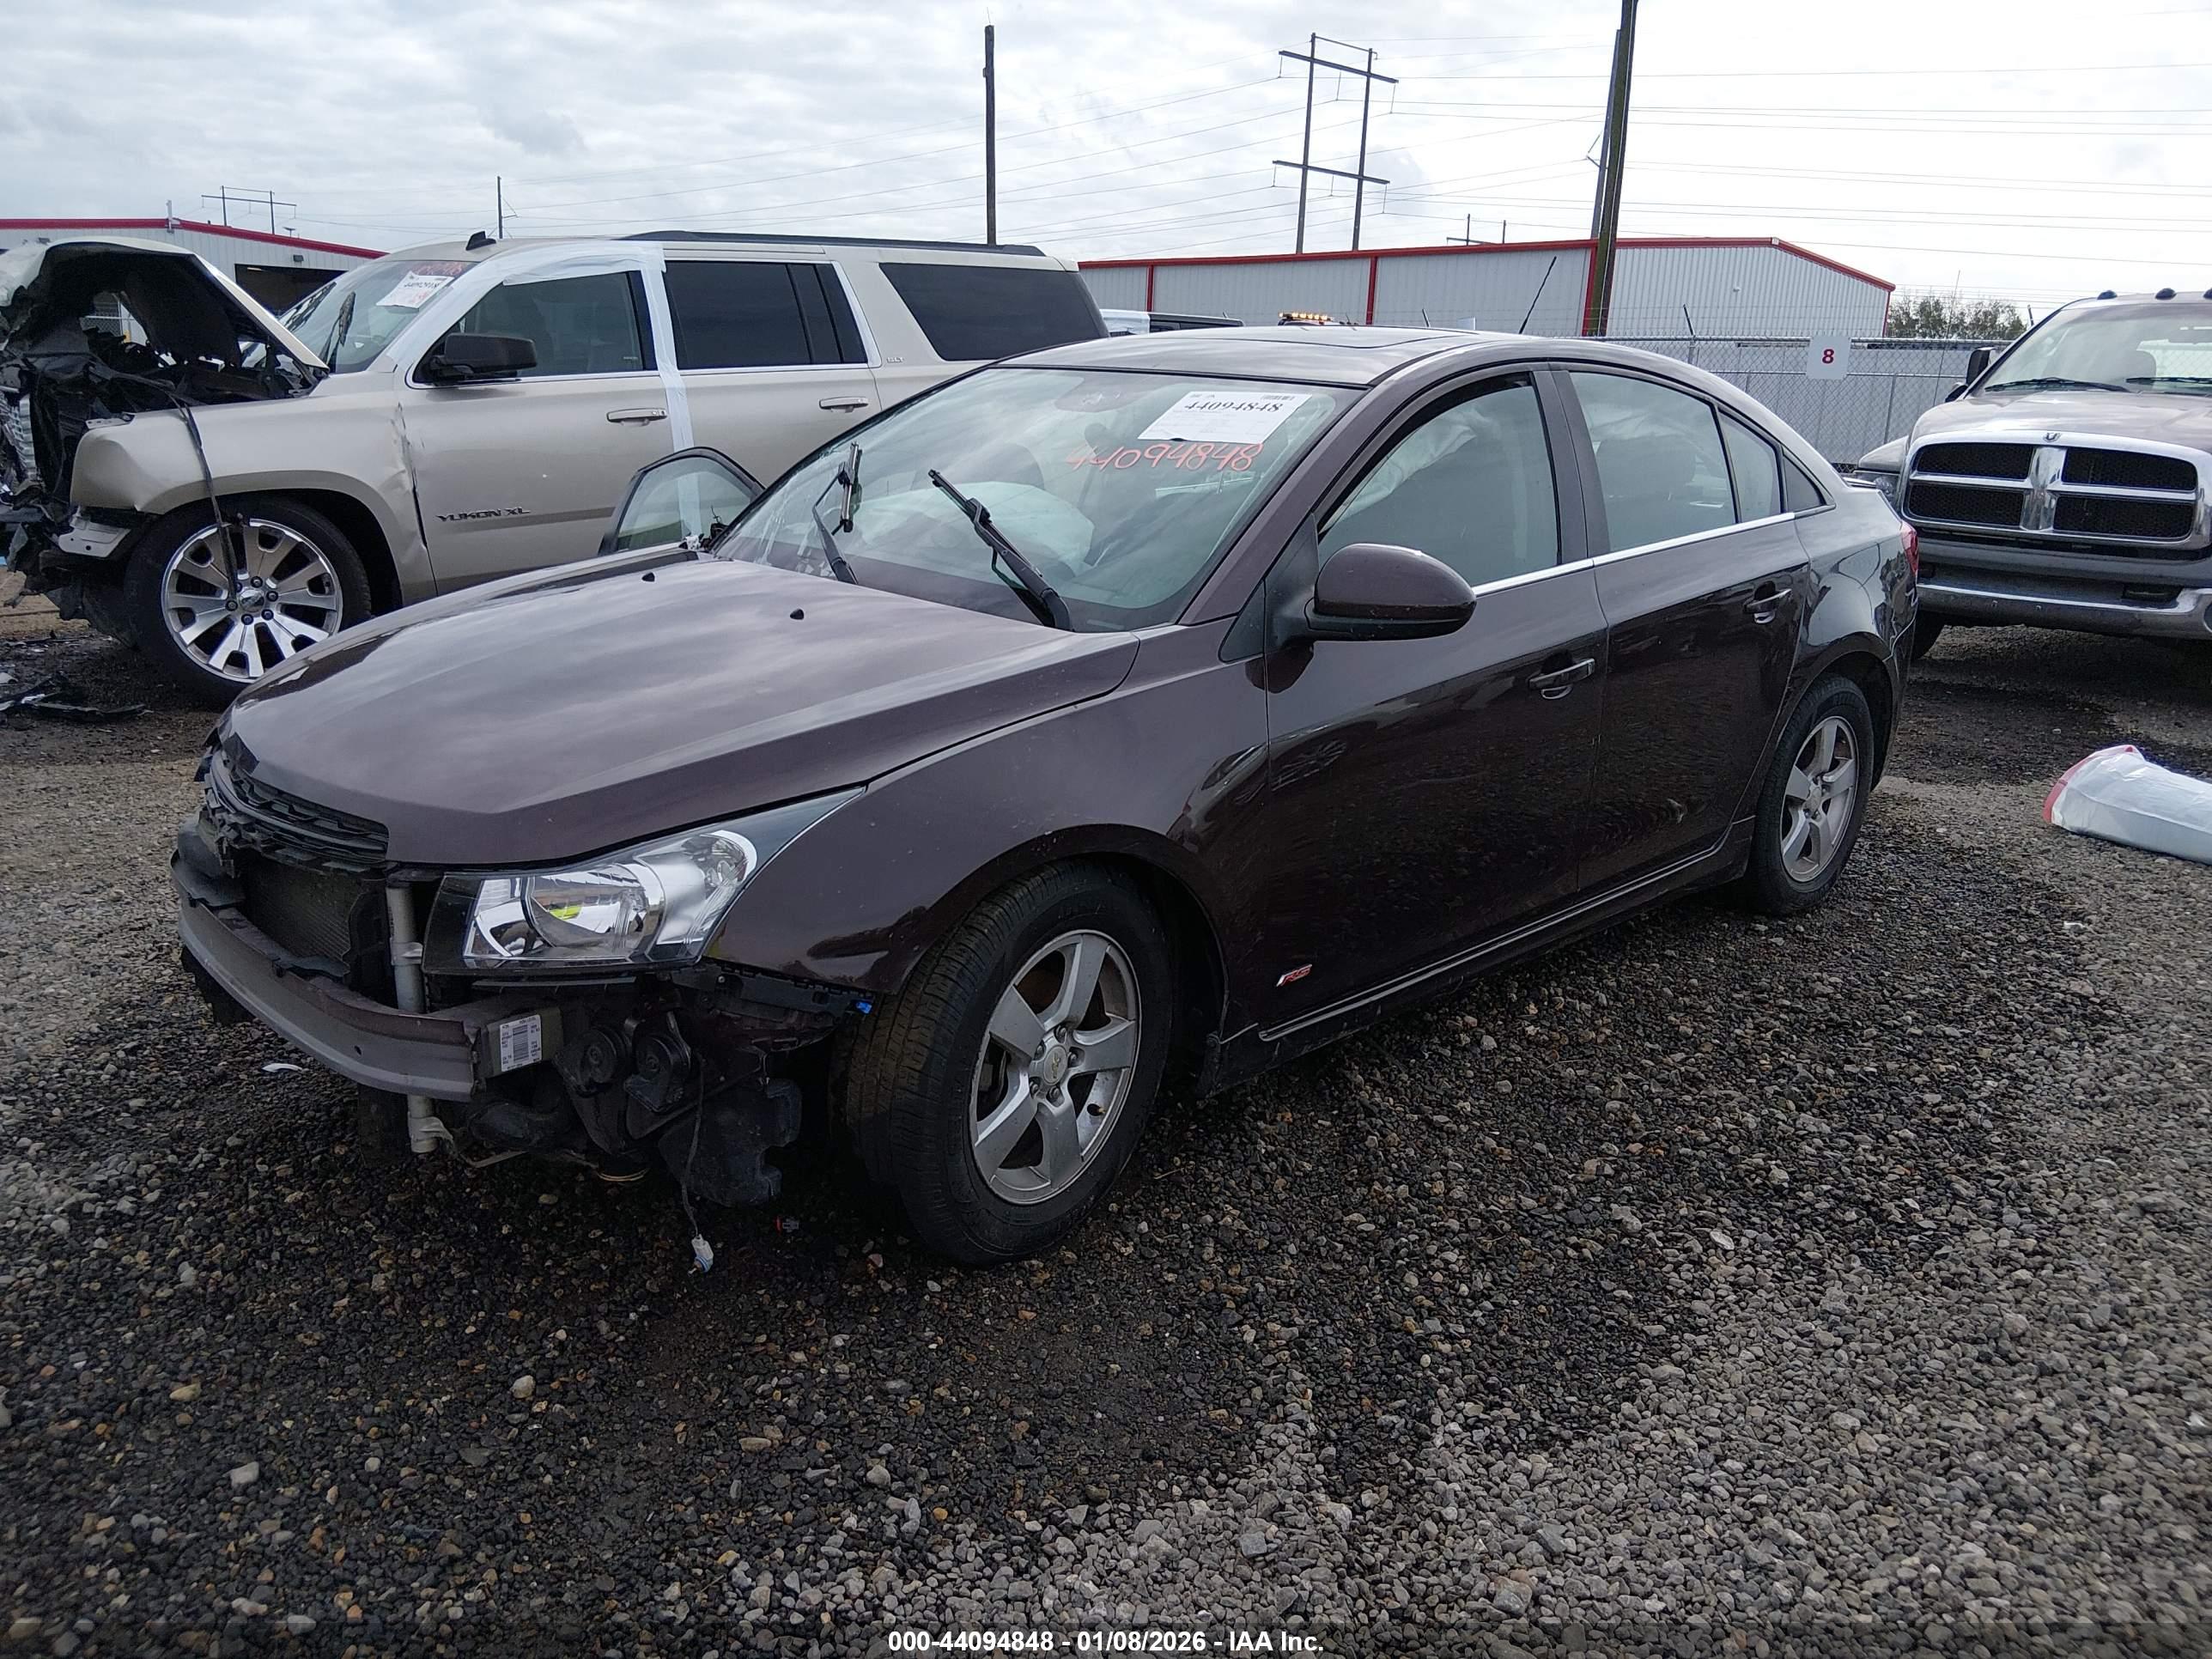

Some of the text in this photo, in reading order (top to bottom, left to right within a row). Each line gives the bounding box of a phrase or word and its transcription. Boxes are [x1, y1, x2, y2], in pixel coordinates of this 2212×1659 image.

[1821, 349, 1835, 364] 8
[1184, 400, 1284, 413] 44094848
[1065, 442, 1265, 471] 44094848
[435, 506, 531, 521] YUKON XL
